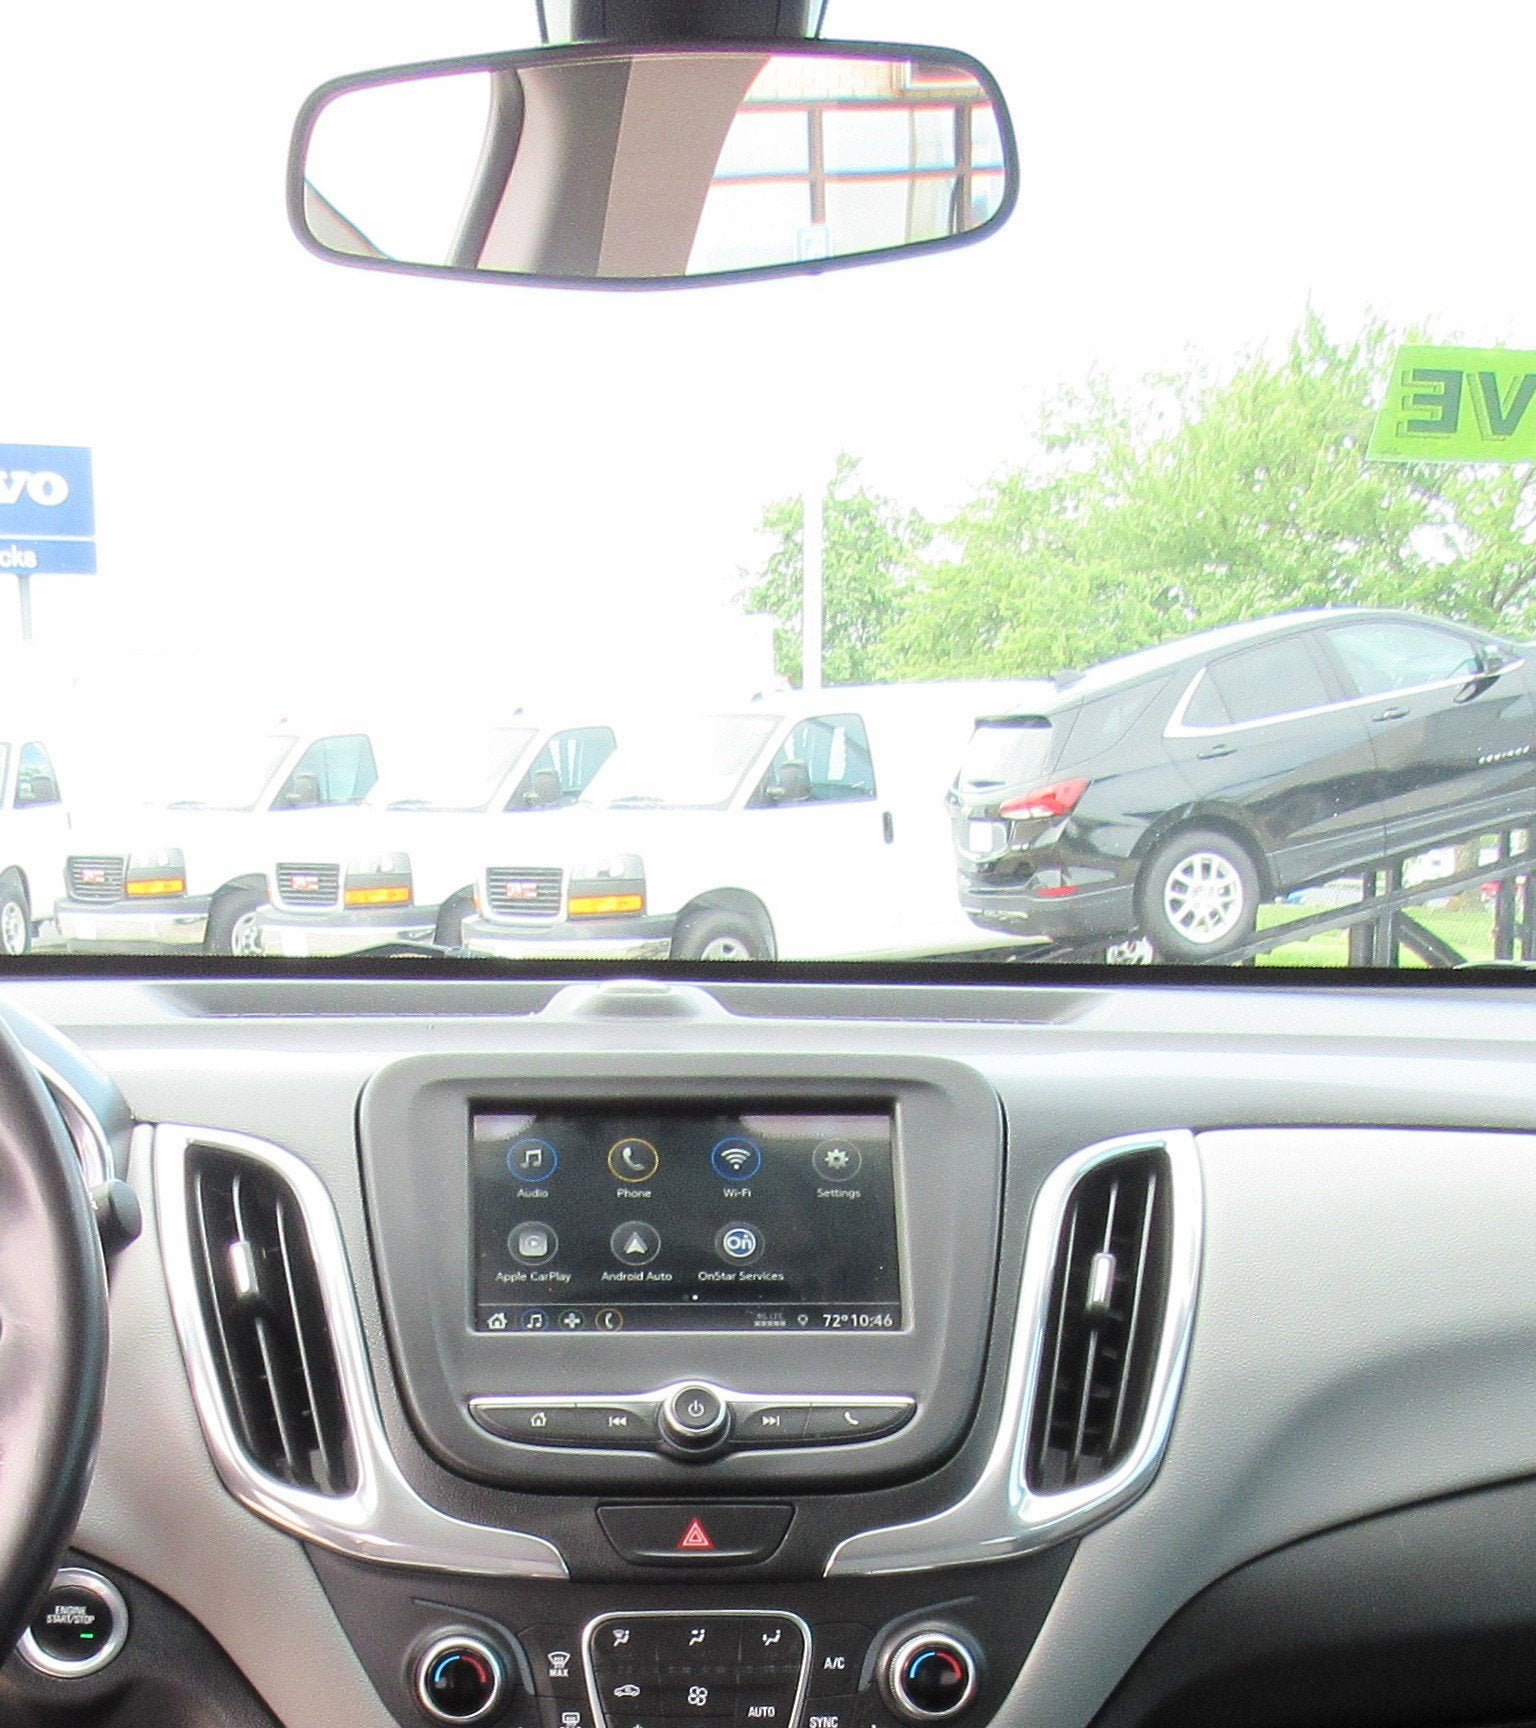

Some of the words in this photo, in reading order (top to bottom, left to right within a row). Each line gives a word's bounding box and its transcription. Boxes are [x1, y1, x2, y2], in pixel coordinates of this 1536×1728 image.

[517, 1188, 549, 1198] Audio
[617, 1188, 652, 1198] Phone
[723, 1188, 752, 1198] Wi-Fi
[817, 1188, 861, 1200] Settings
[495, 1271, 527, 1283] Apple
[530, 1271, 572, 1284] CarPlay
[601, 1271, 644, 1282] Android
[645, 1271, 673, 1282] Auto
[698, 1271, 737, 1281] OnStar
[739, 1271, 784, 1281] Services
[851, 1313, 893, 1327] 10:46
[824, 1656, 845, 1670] A/C
[549, 1668, 569, 1678] MAX
[748, 1706, 776, 1718] AUTO
[809, 1716, 839, 1728] SYNC
